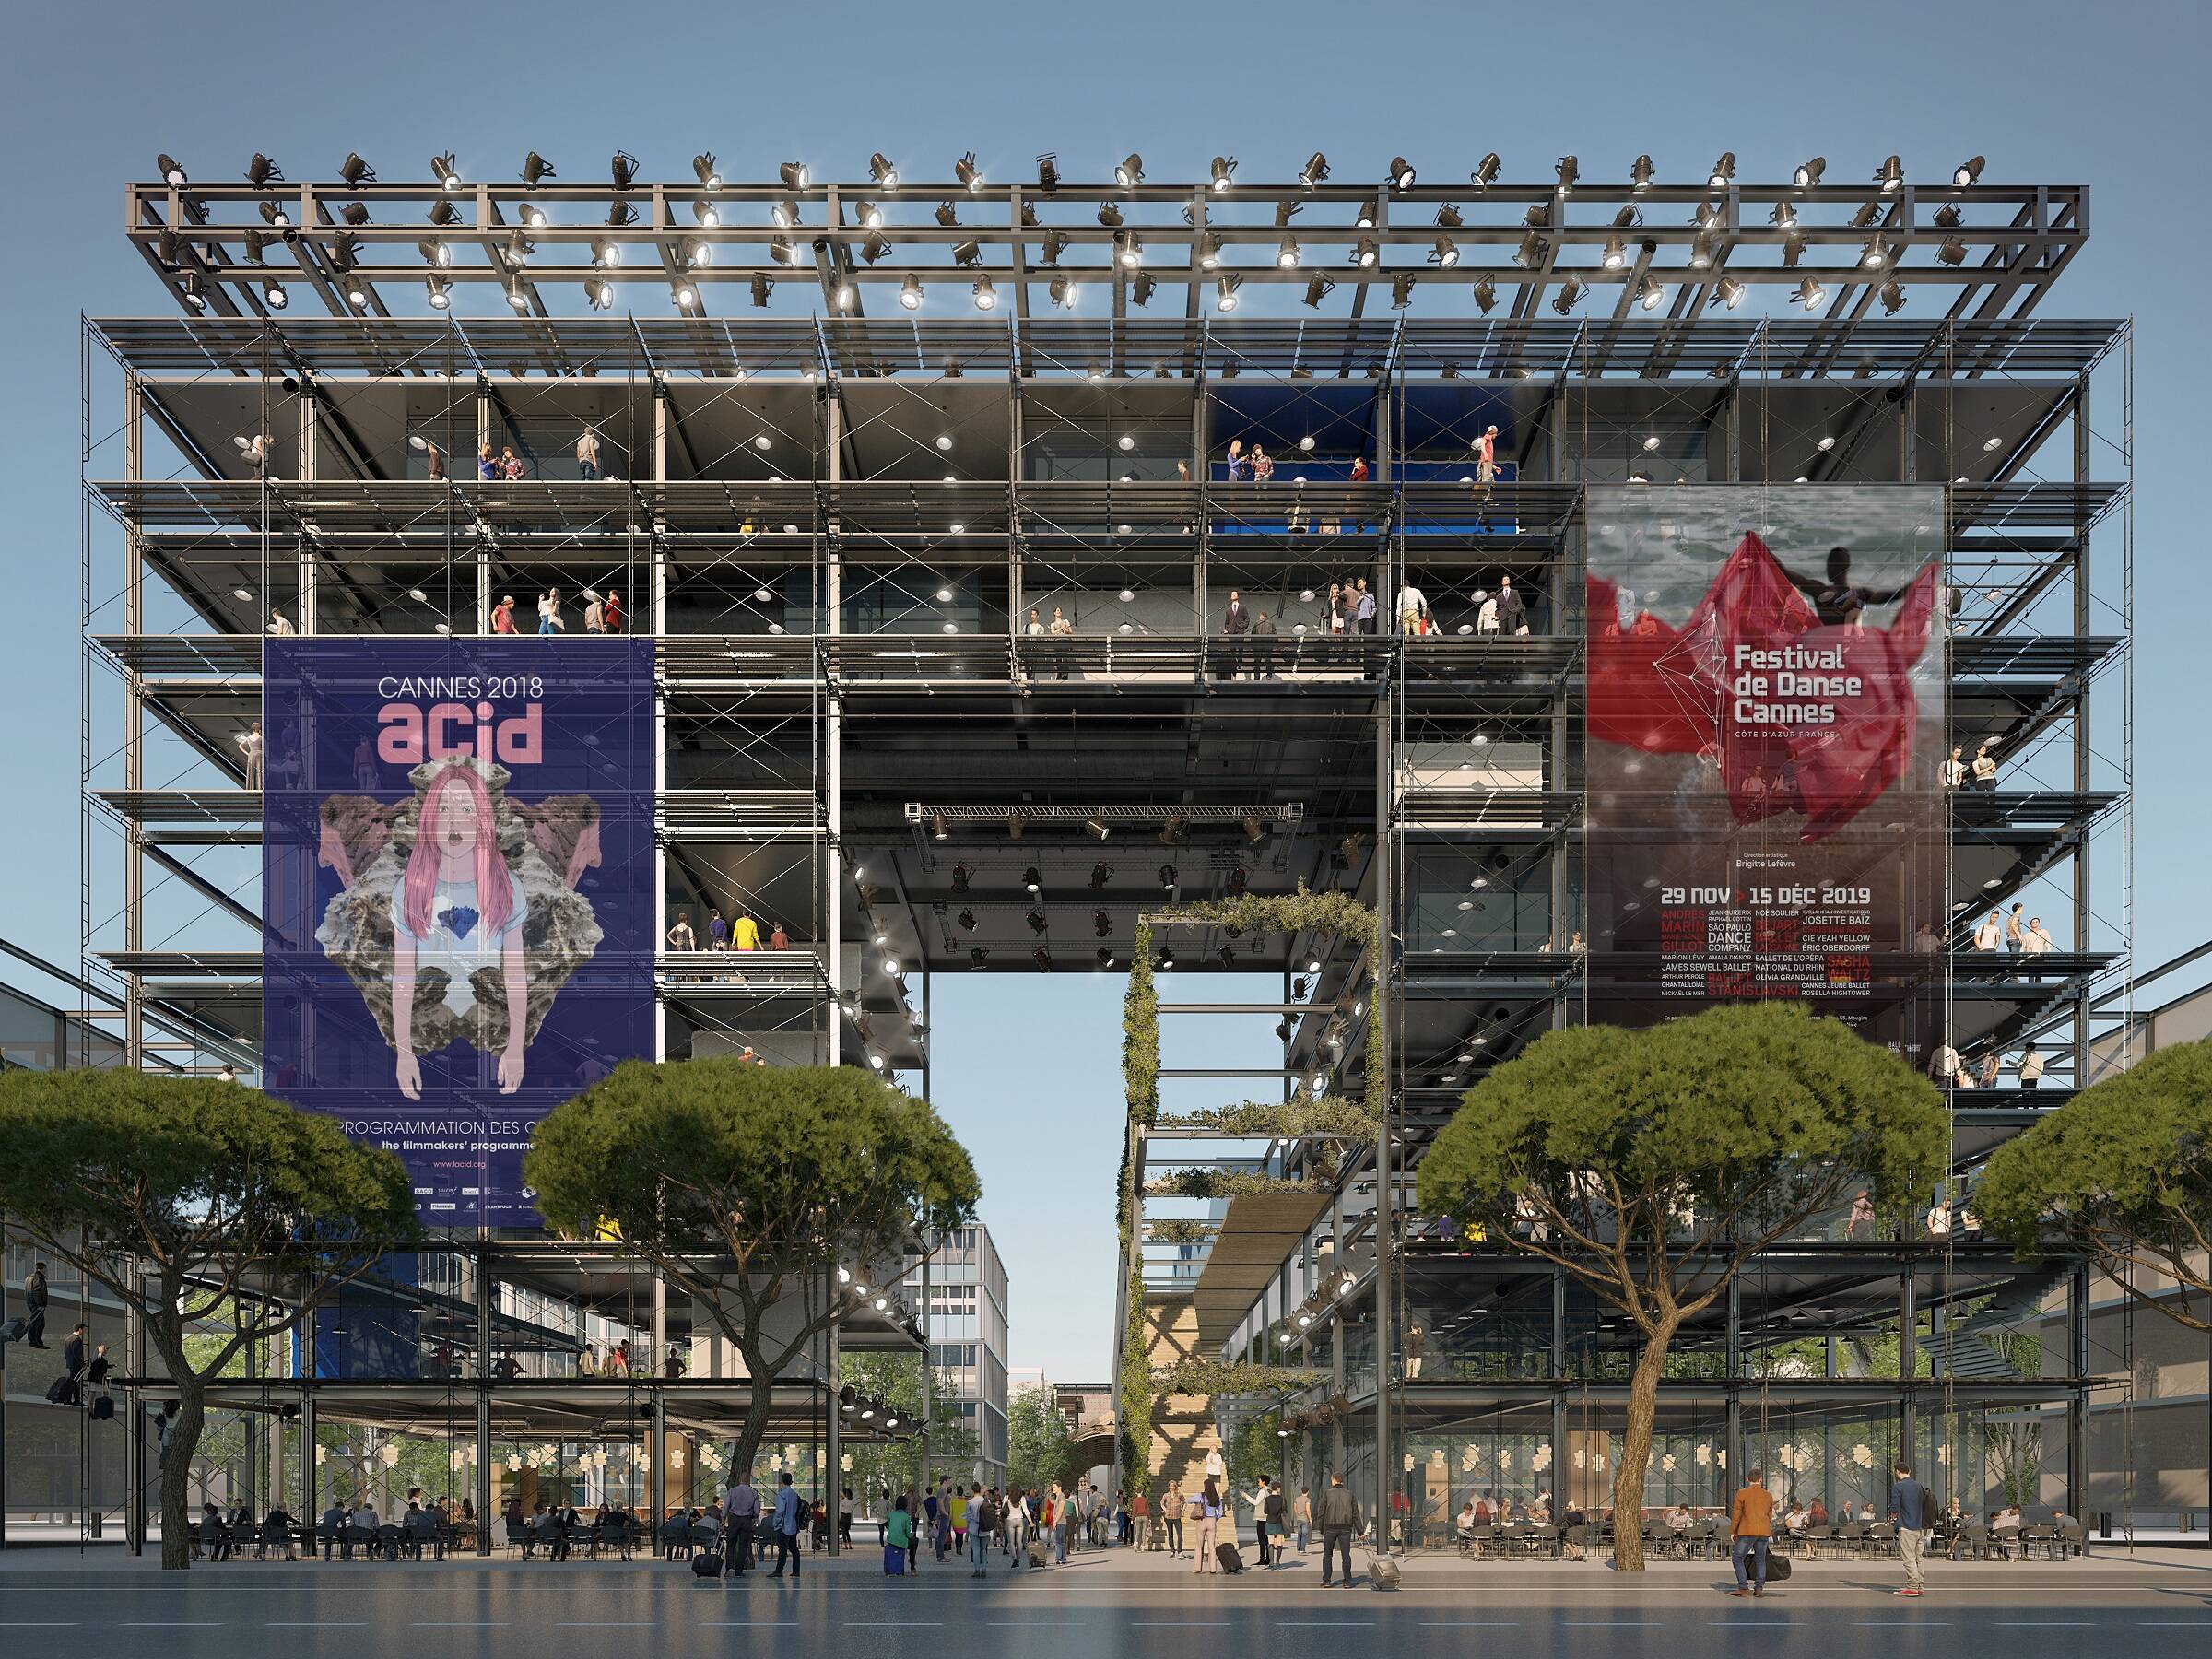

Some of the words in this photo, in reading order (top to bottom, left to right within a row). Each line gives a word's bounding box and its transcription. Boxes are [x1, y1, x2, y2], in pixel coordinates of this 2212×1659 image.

[1735, 644, 1845, 669] Festival
[378, 677, 480, 698] CANNES
[488, 677, 544, 698] 2018
[1735, 671, 1768, 696] de
[1778, 672, 1862, 696] Danse
[1735, 699, 1835, 724] Cannes
[378, 701, 542, 764] acid
[1735, 729, 1759, 738] CÔTE
[1736, 859, 1765, 869] Brigitte
[1768, 859, 1796, 867] Lefèvre
[1662, 887, 1686, 904] 29
[1691, 887, 1730, 904] NOV
[1749, 887, 1772, 904] 15
[1778, 883, 1816, 904] DÉC
[1822, 887, 1871, 904] 2019
[1755, 908, 1769, 916] NOÉ
[1803, 916, 1846, 924] JOSETTE
[1849, 913, 1871, 924] BAÏZ
[1709, 923, 1724, 932] SÃO
[1709, 932, 1751, 943] DANCE
[1662, 941, 1704, 951] GILLOT
[1709, 944, 1751, 952] COMPANY
[1802, 943, 1820, 952] ÉRIC
[1822, 944, 1871, 952] OBERDORFF
[1794, 953, 1824, 961] L'OPÉRA
[1827, 955, 1871, 967] SASHA
[1755, 963, 1792, 971] NATIONAL
[1794, 963, 1805, 971] DU
[1806, 963, 1824, 971] RHIN
[1827, 969, 1871, 982] WALTZ
[1708, 984, 1799, 996] STANISLAVSKI
[490, 1121, 520, 1135] DES
[382, 1140, 400, 1150] the
[470, 1142, 535, 1152] programme
[433, 1160, 486, 1170] www.lacid.org
